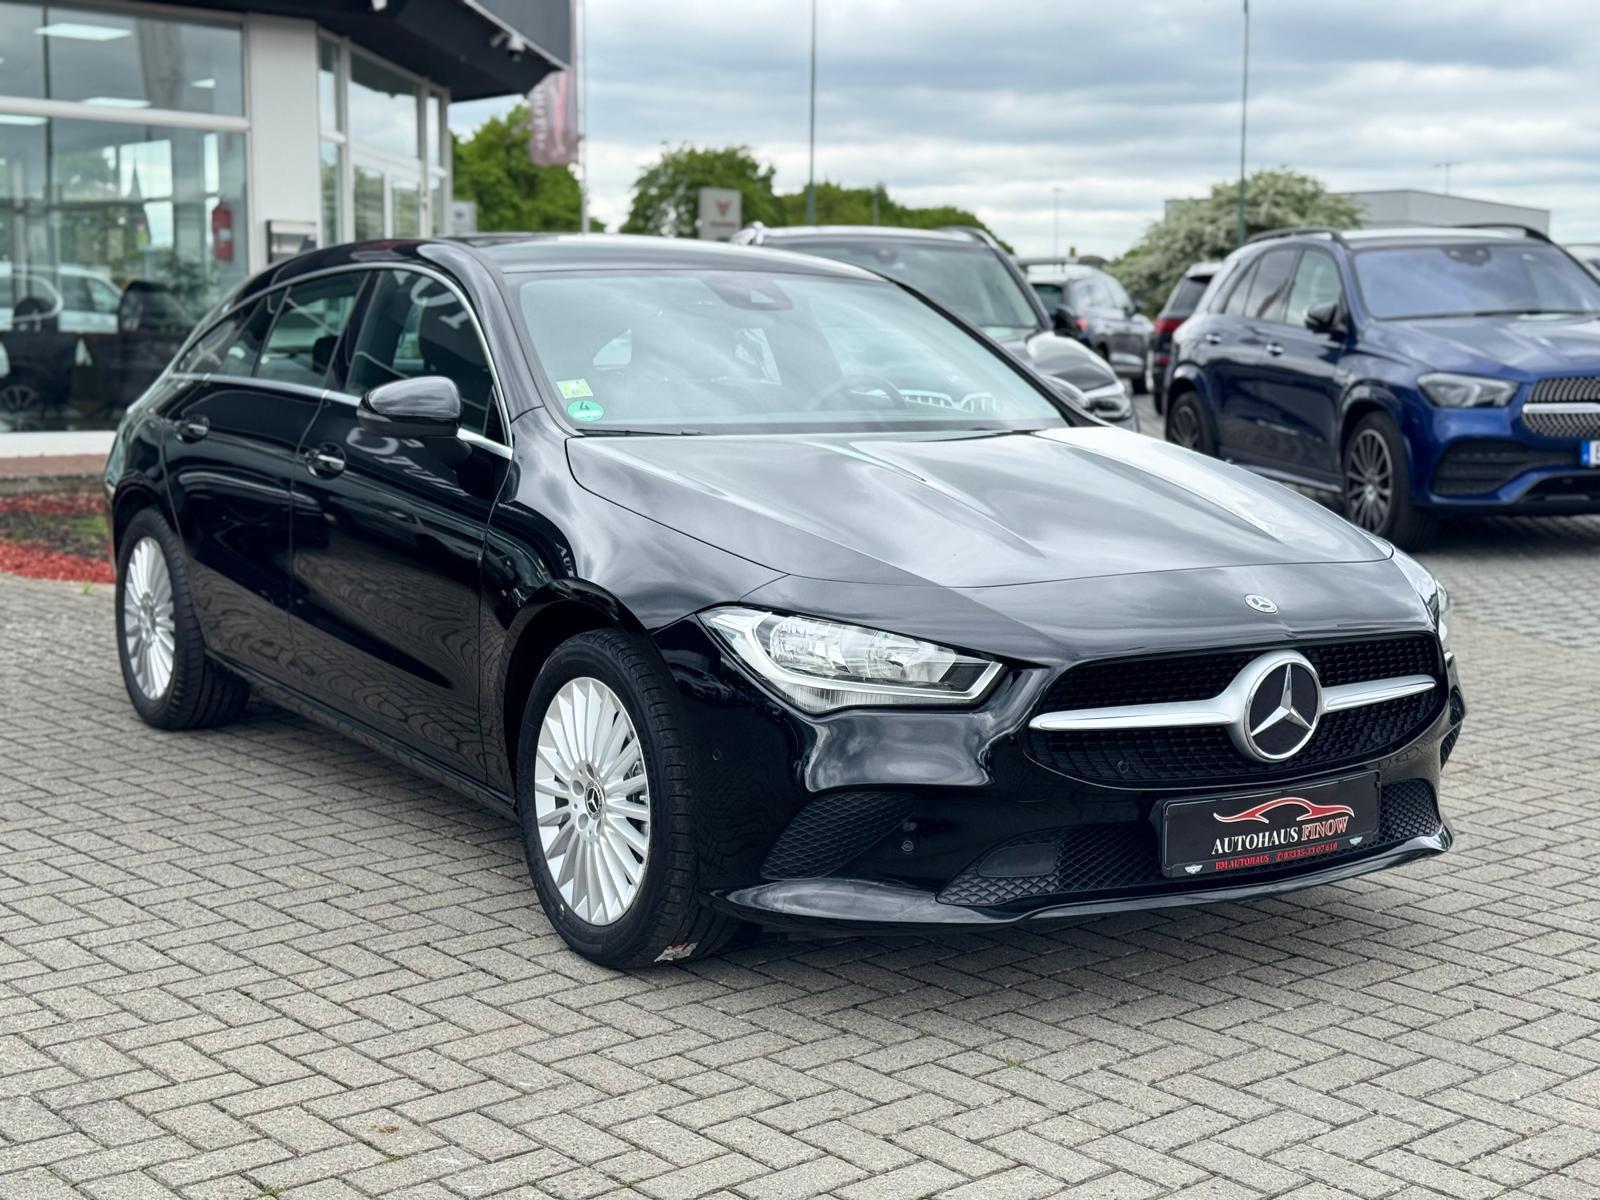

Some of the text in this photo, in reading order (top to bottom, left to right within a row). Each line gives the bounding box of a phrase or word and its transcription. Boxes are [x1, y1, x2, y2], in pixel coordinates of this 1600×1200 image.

[579, 401, 590, 410] 4
[1211, 816, 1349, 855] AUTOHAUS FINOW
